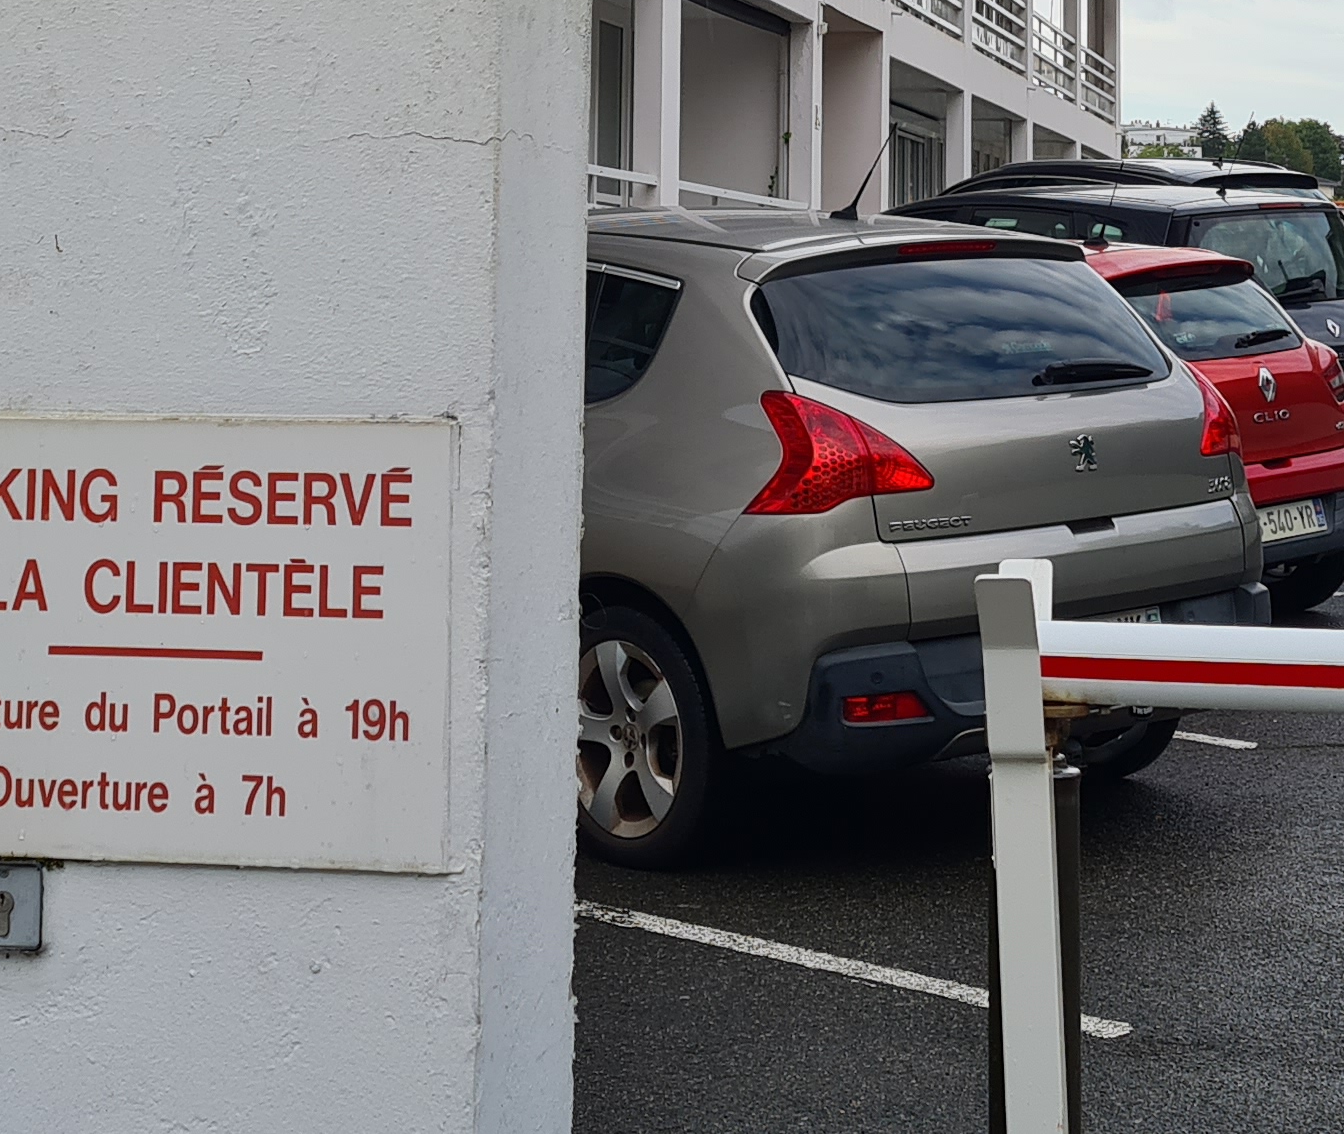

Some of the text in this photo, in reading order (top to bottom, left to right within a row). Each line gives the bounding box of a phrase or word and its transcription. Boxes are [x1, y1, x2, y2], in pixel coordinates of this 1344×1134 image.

[1253, 408, 1291, 424] CLIO
[153, 465, 413, 528] RÉSERVÉ
[888, 514, 973, 533] PEUGEOT
[83, 558, 385, 620] CLIENTÈLE
[84, 692, 130, 733] du
[152, 693, 274, 736] Portail
[297, 698, 320, 739] à
[345, 699, 411, 742] 19h
[194, 773, 217, 815] à
[242, 774, 288, 817] 7h
